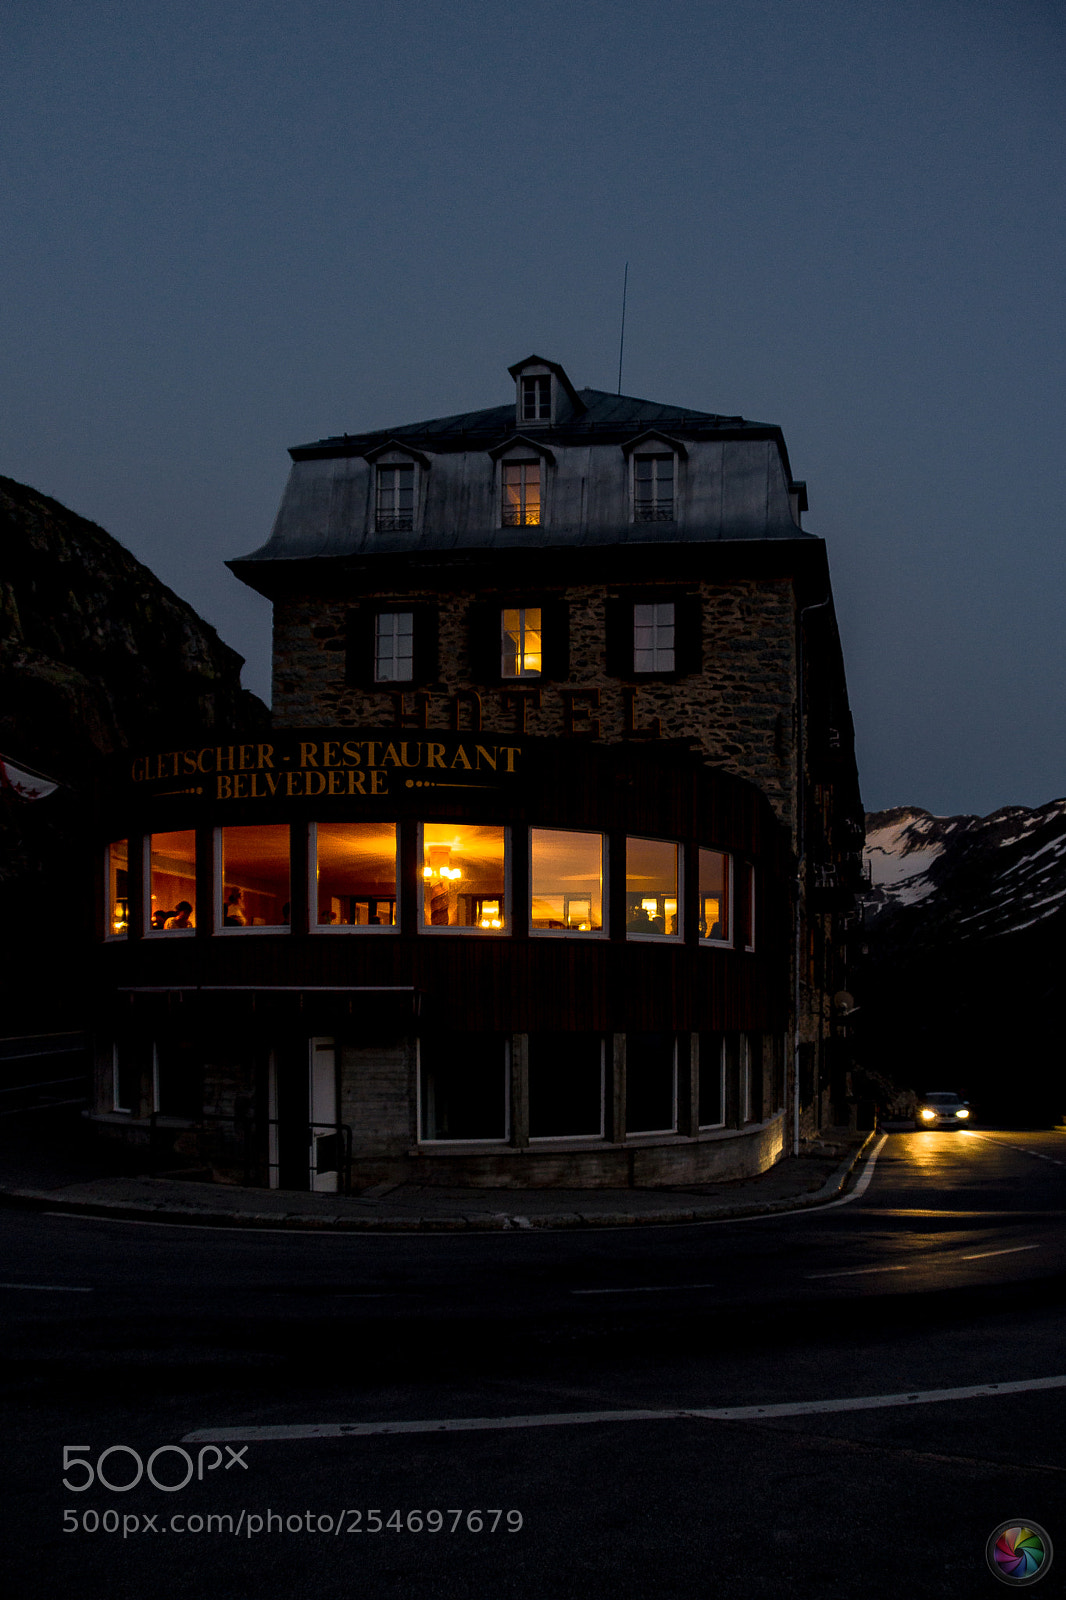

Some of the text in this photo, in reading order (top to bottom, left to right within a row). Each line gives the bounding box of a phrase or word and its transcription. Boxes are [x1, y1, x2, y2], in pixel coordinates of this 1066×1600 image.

[391, 686, 662, 739] HOTEL
[130, 743, 276, 783] GLETSCHER
[300, 741, 522, 773] RESTAURANT
[216, 770, 389, 800] BELVEDERE
